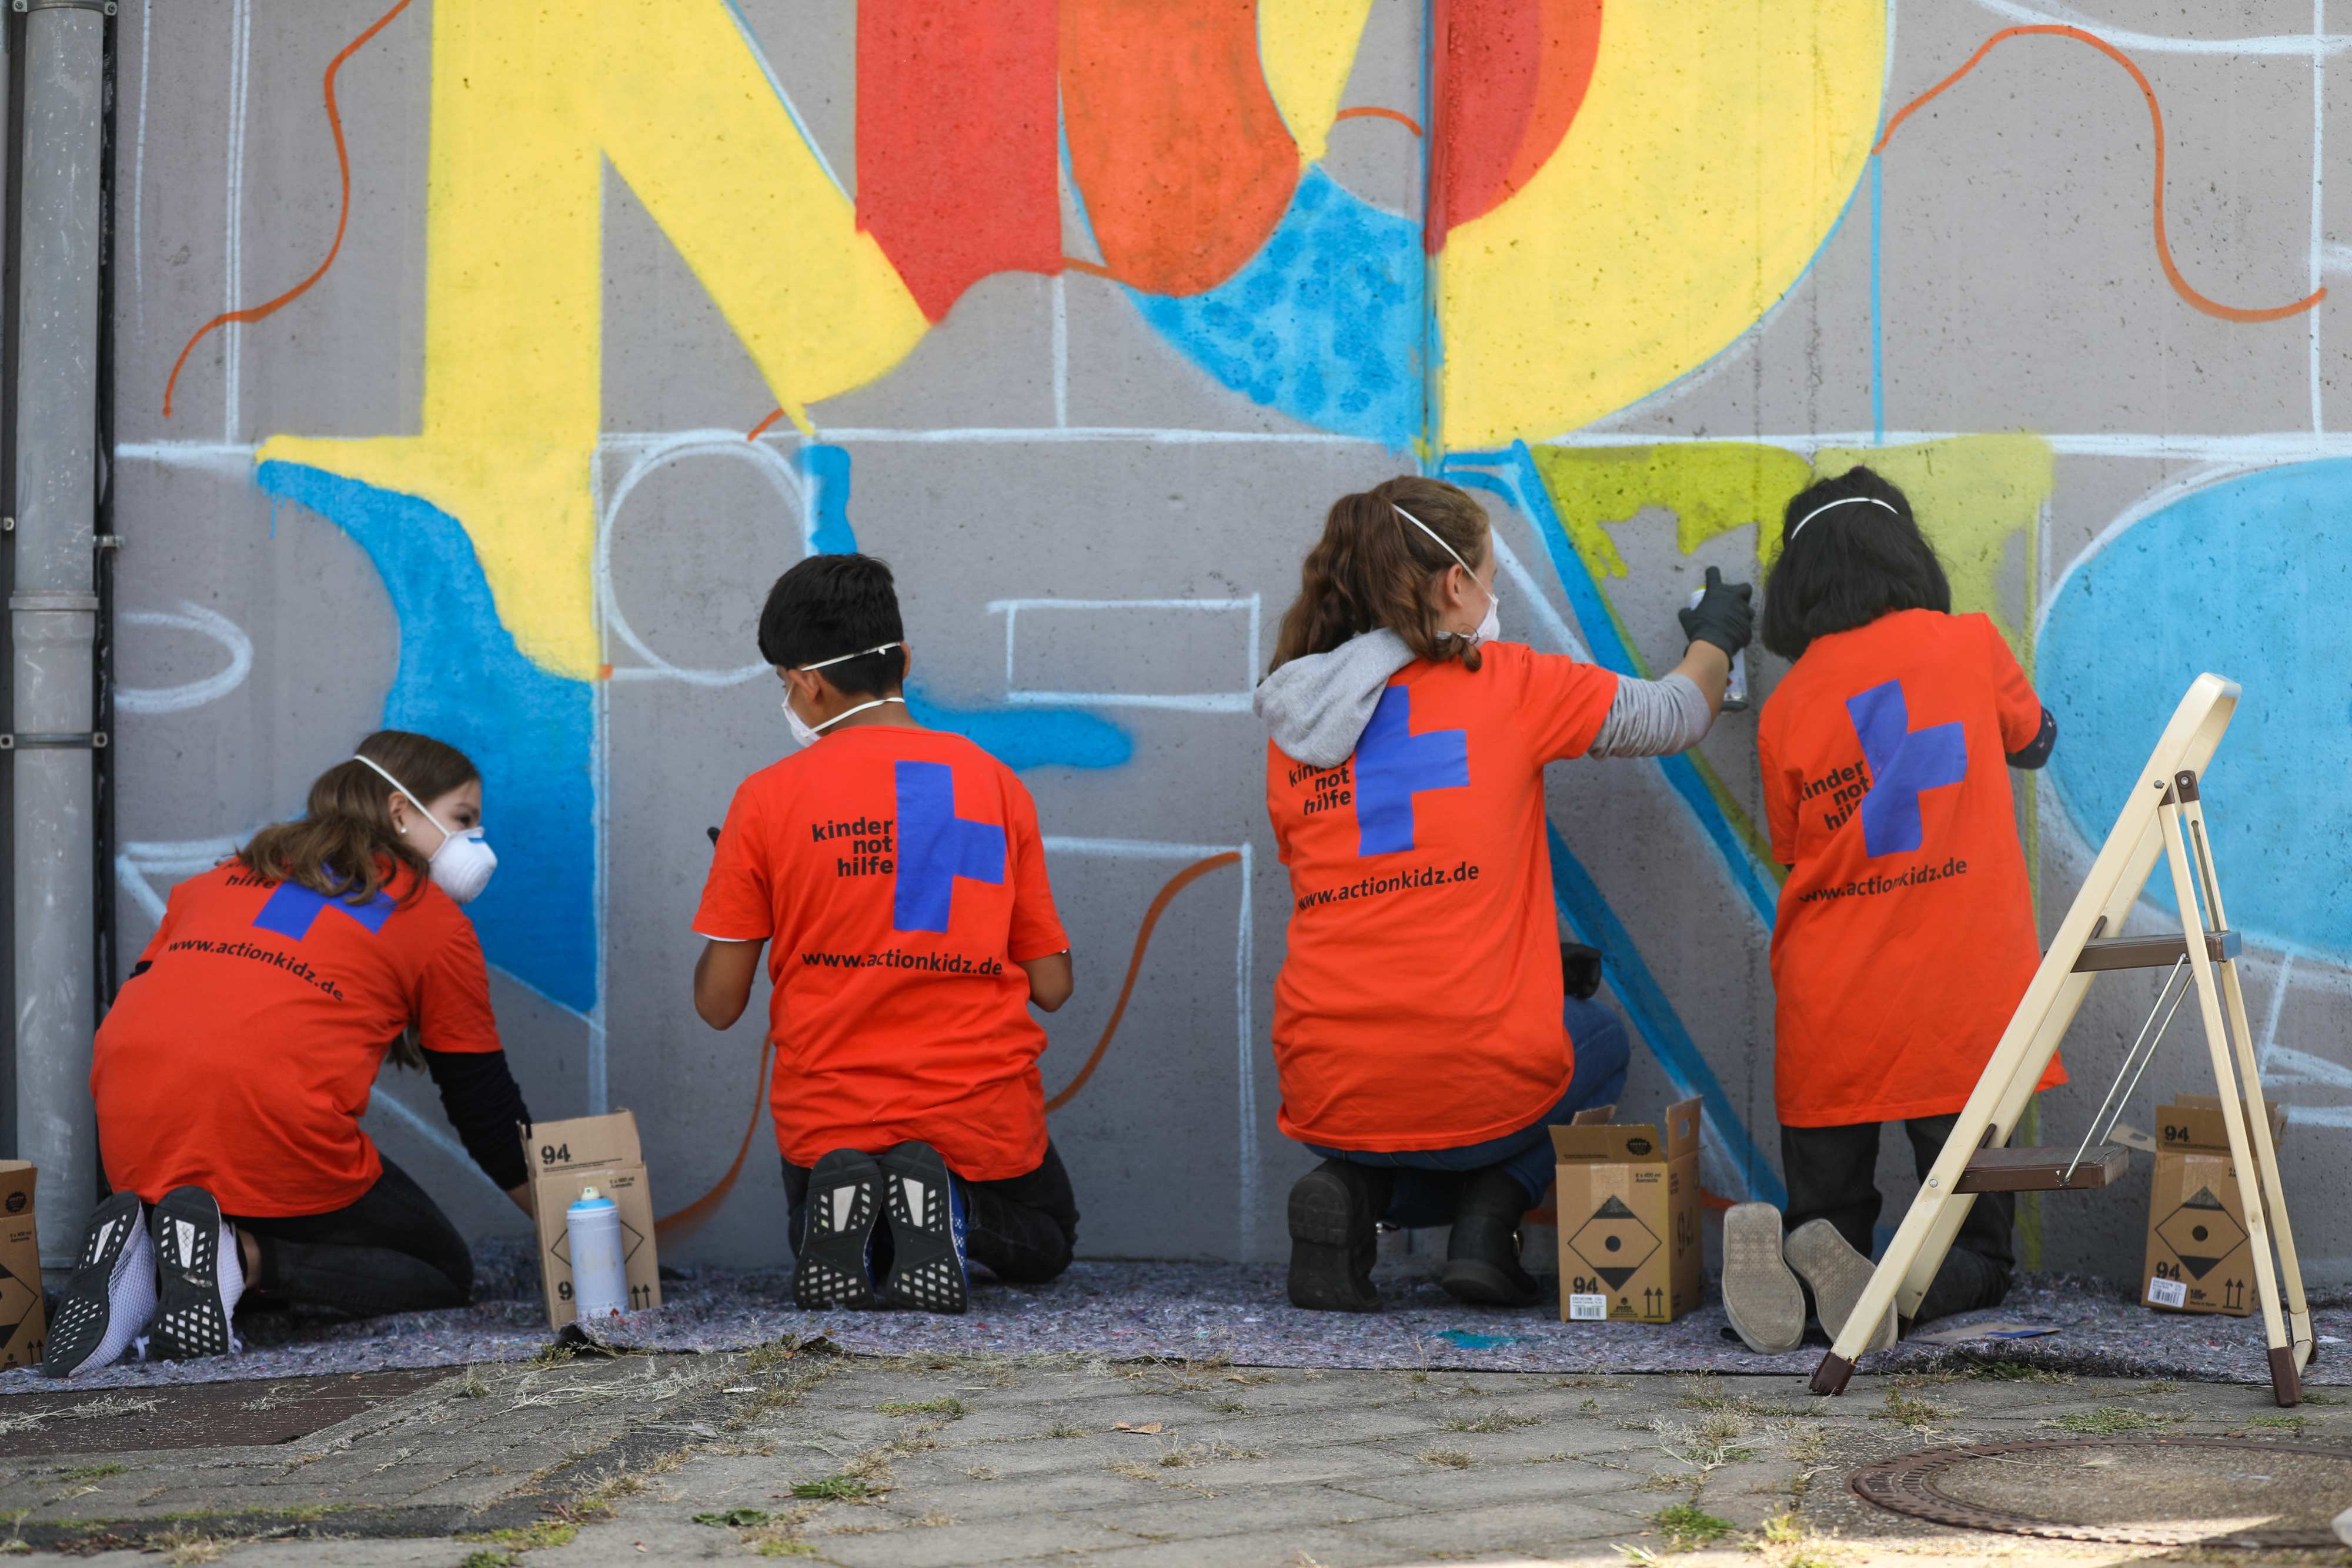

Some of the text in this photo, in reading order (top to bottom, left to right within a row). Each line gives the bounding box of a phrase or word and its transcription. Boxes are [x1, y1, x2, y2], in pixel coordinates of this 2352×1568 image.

[1315, 767, 1350, 792] not
[1800, 760, 1863, 801] inder
[1833, 776, 1870, 805] not
[1304, 789, 1351, 815] hilfe
[1824, 798, 1862, 831] hil
[811, 817, 893, 842] kinder
[853, 835, 893, 854] not
[837, 856, 894, 877] hilfe
[226, 874, 276, 889] hilfe
[1298, 861, 1479, 911] www.actionkidz.de
[168, 939, 343, 1001] www.actionkidz.de
[801, 949, 1003, 975] www.actionkidz.de
[2164, 1125, 2190, 1142] 94
[541, 1144, 571, 1165] 94
[2156, 1261, 2181, 1280] 94
[1573, 1276, 1598, 1293] 94
